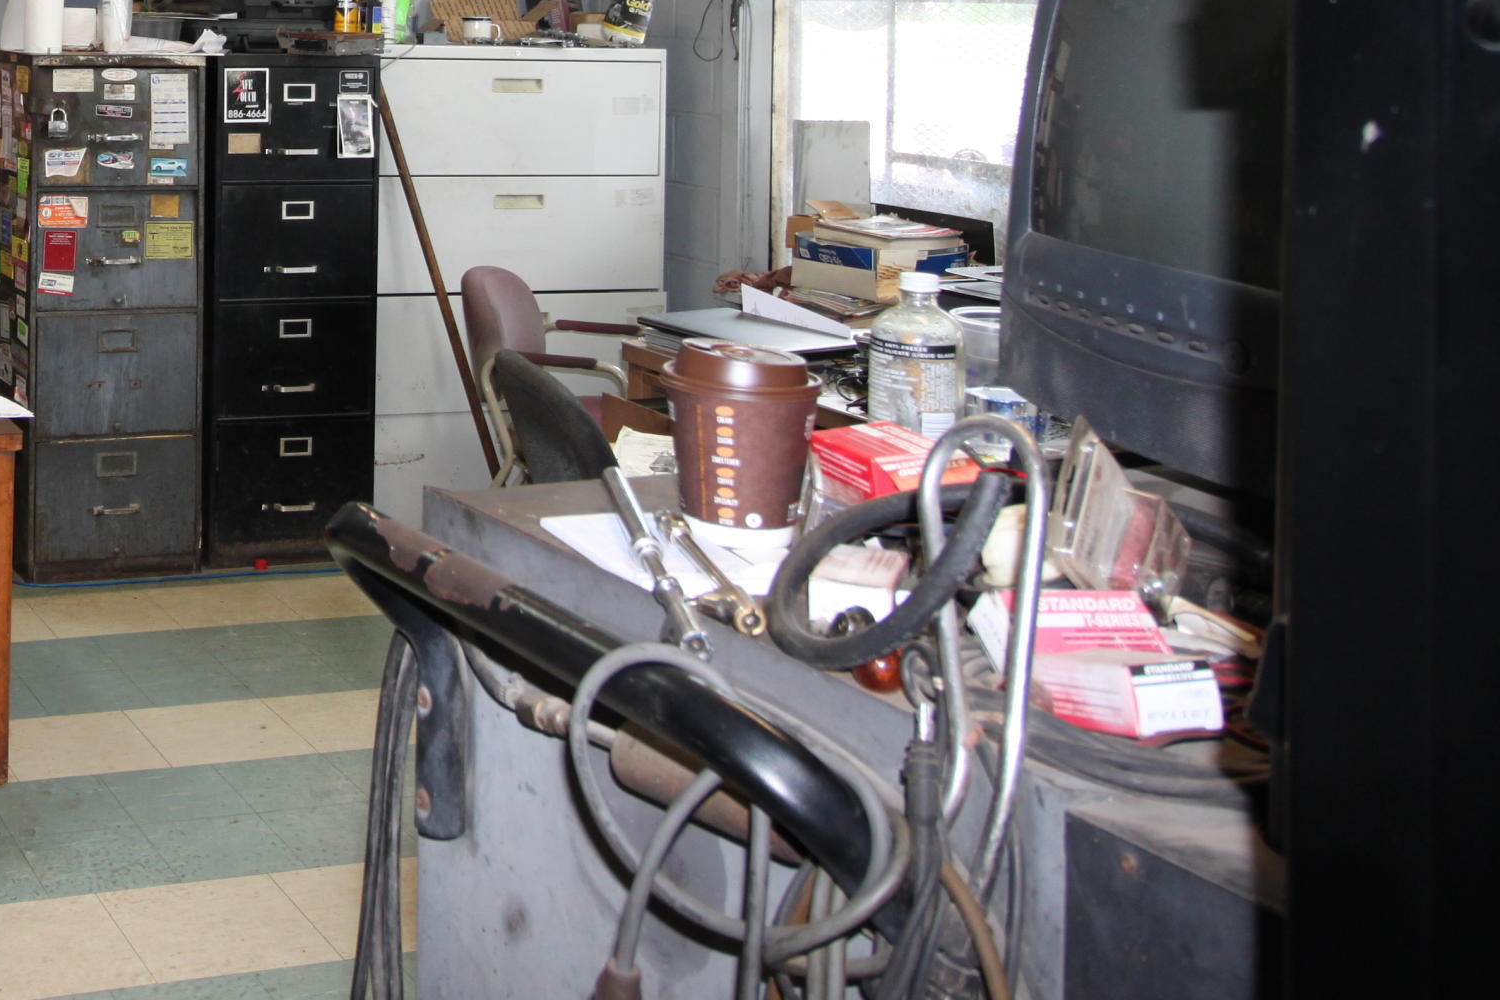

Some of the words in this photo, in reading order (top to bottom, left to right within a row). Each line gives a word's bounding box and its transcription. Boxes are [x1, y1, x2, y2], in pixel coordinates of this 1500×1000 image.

[228, 109, 267, 119] 886-4664
[1037, 597, 1137, 613] STANDARD
[1083, 613, 1141, 628] T-SERIES
[1143, 662, 1195, 675] STANDARD
